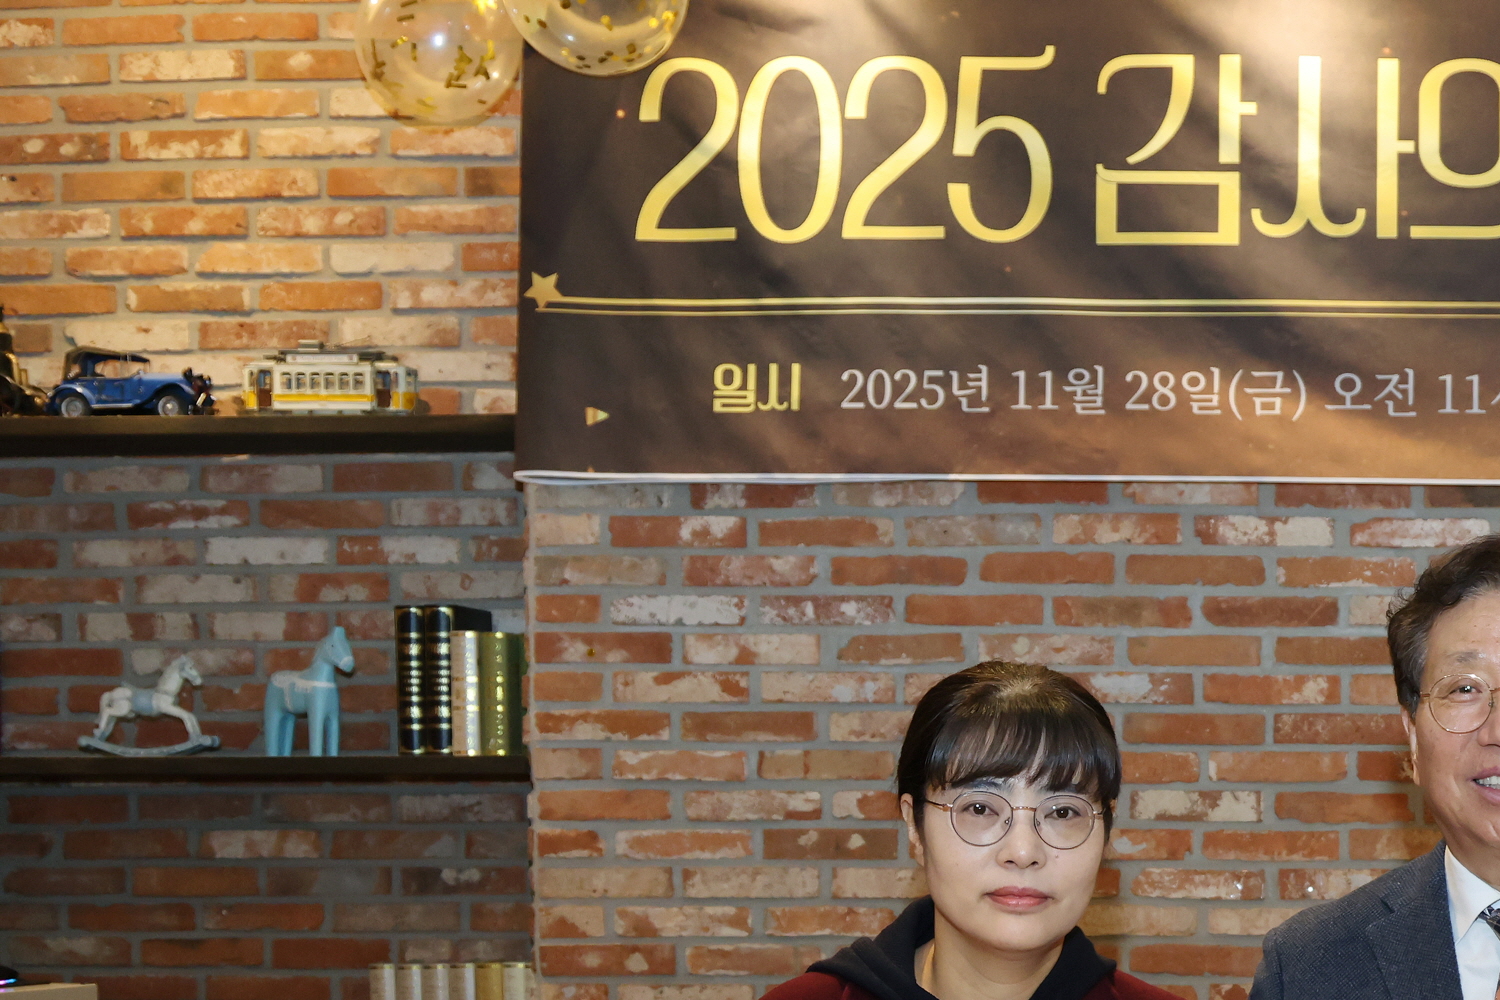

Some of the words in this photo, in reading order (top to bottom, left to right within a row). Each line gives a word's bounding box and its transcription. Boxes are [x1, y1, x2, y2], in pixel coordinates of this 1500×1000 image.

[634, 44, 1056, 244] 2025
[711, 361, 802, 414] 일시
[840, 364, 991, 414] 2025년
[1009, 365, 1107, 415] 11월
[1123, 367, 1307, 420] 28일(금)
[1325, 369, 1417, 417] 오전
